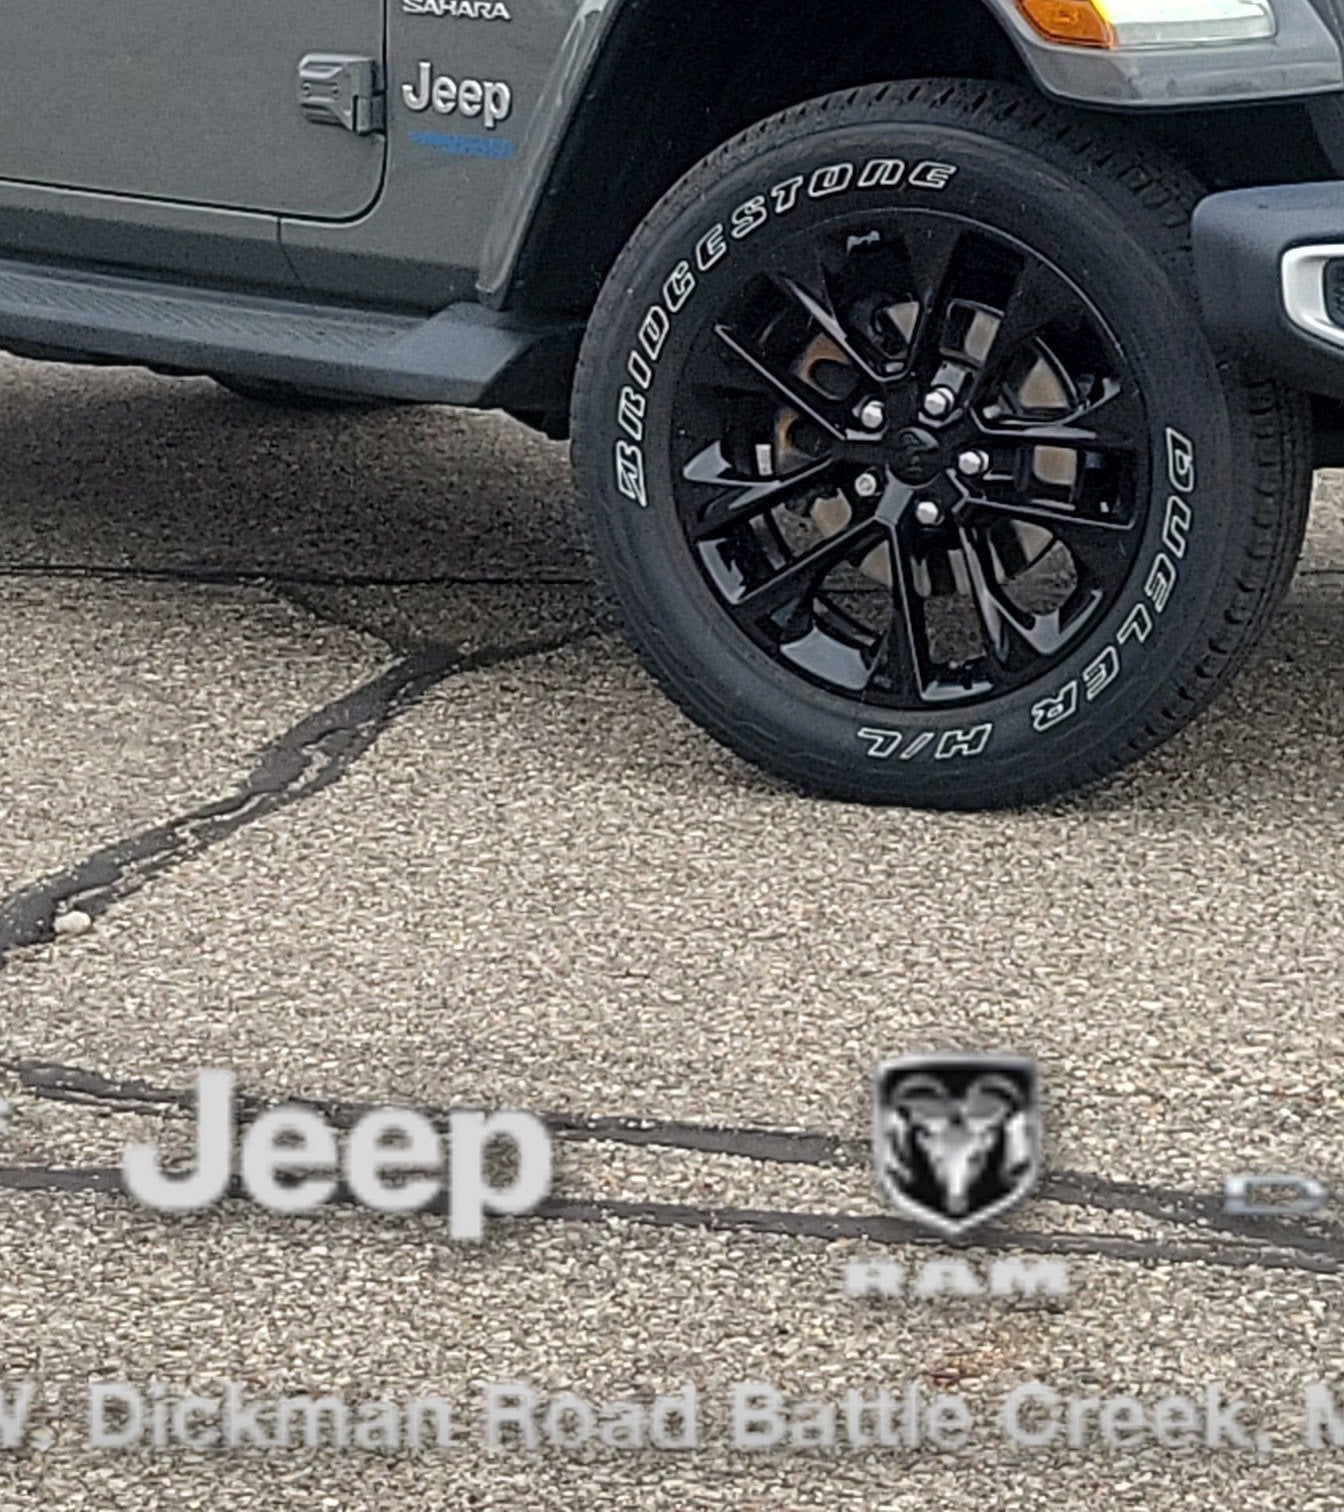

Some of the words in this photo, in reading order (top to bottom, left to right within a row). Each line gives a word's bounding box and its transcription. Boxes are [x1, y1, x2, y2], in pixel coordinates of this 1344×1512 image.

[402, 61, 512, 129] Jeep
[615, 157, 957, 508] BRIDGESTONE
[1030, 428, 1197, 732] DUELER
[856, 722, 994, 761] H/L
